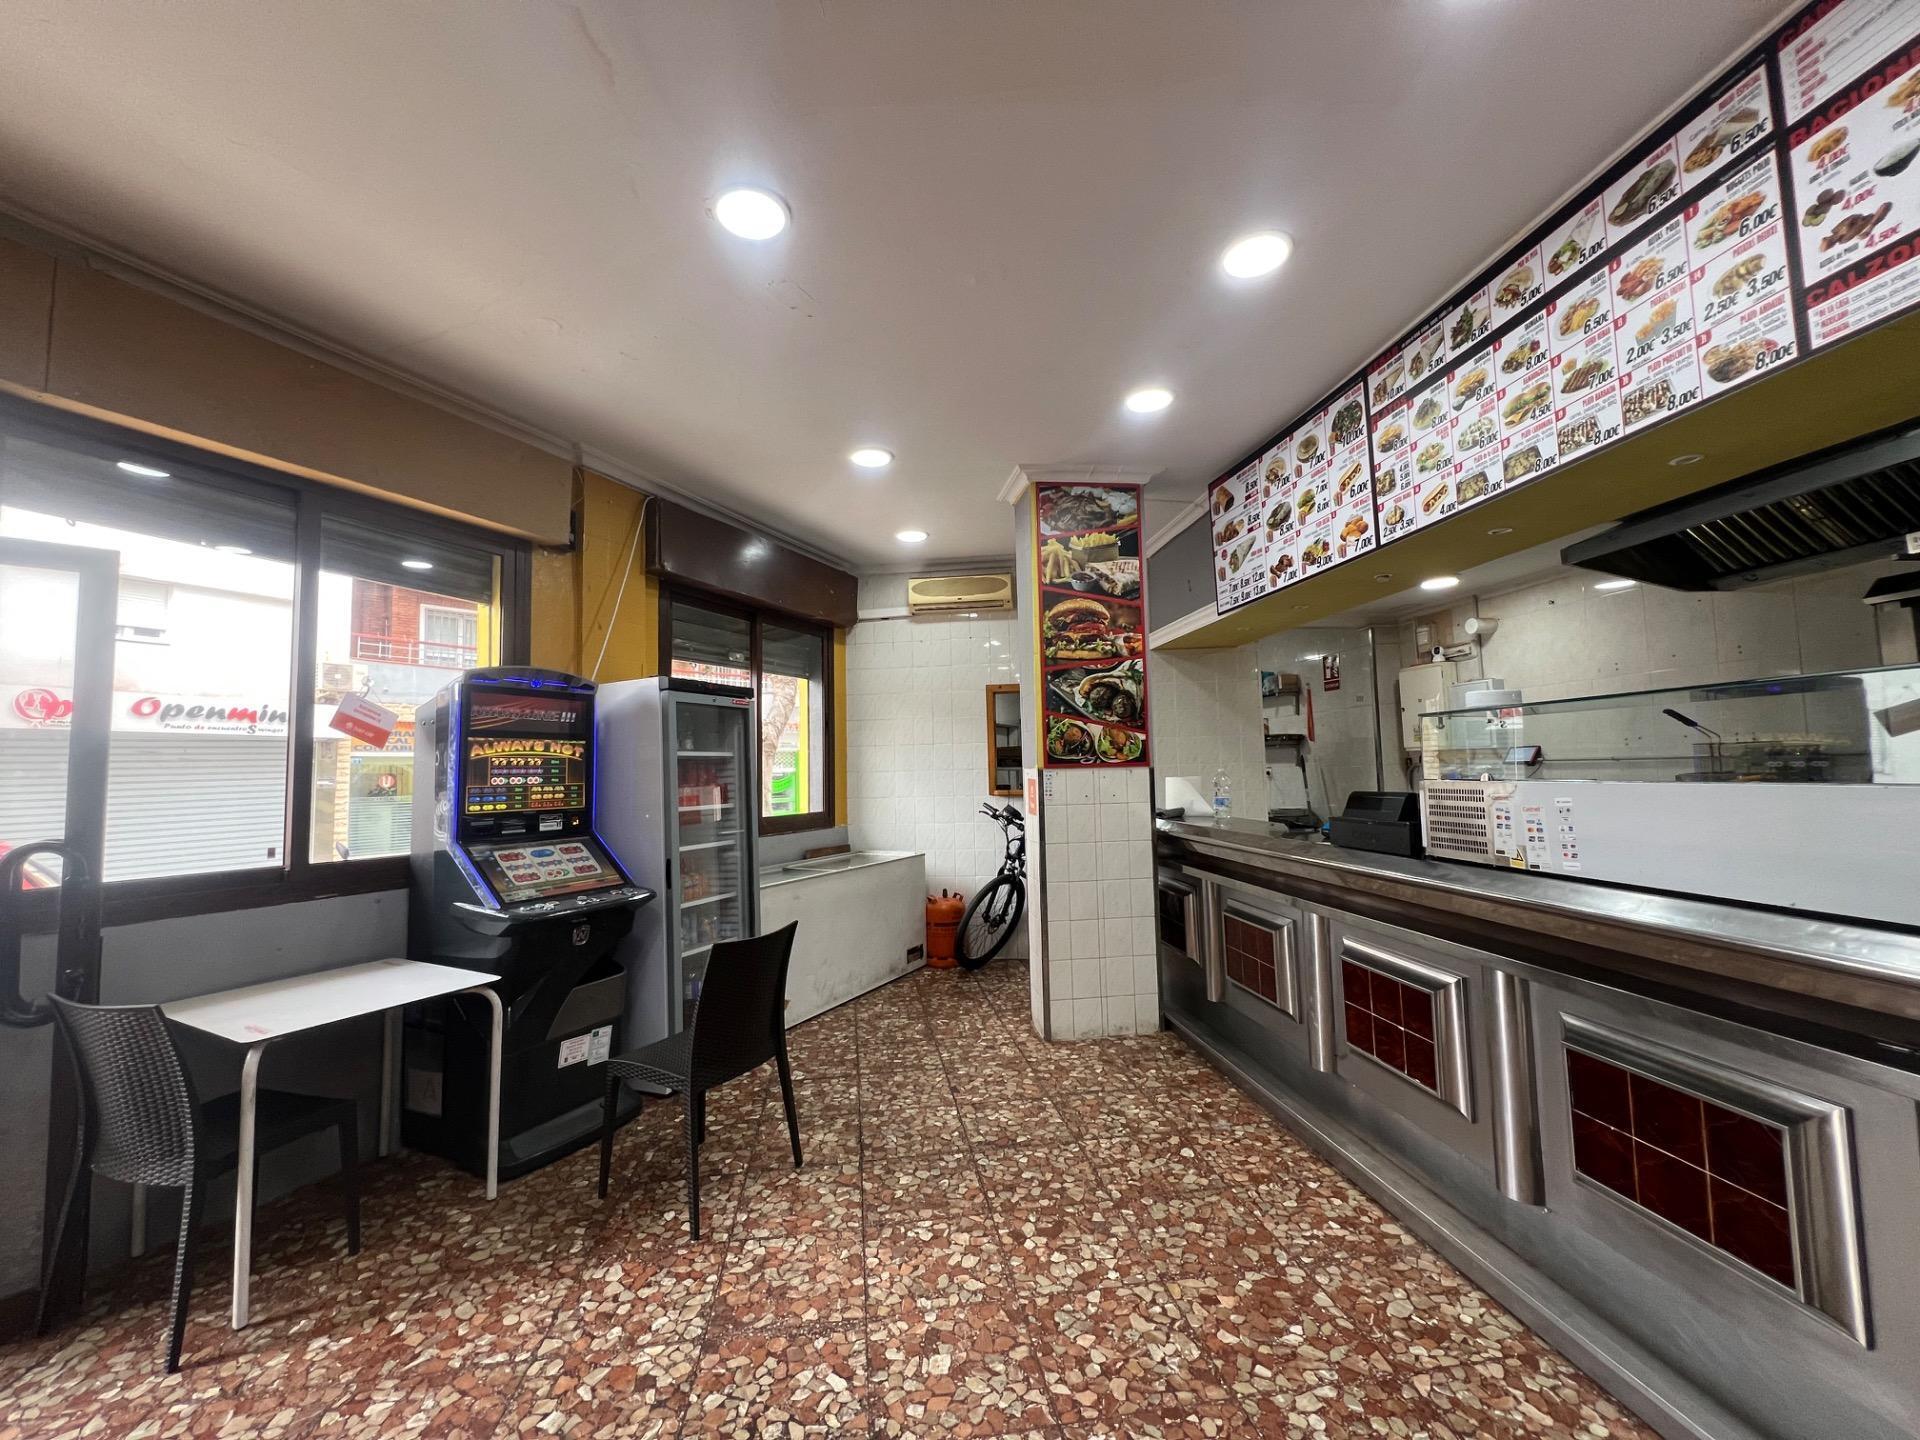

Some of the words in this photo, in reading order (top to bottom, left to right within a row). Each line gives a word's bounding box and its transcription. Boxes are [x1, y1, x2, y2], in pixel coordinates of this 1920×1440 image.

[1729, 118, 1767, 154] 6,50€
[1738, 204, 1777, 237] 6,00€
[1656, 261, 1687, 289] 6,50€
[1747, 266, 1785, 297] 3,50€
[1584, 310, 1609, 334] 6,50€
[1661, 318, 1693, 345] 3,50€
[1755, 342, 1794, 370] 8,00€
[1666, 387, 1699, 411] 8,00€
[1594, 424, 1620, 445] 8,00€
[471, 740, 545, 757] ALWAYS
[550, 742, 585, 757] HOT
